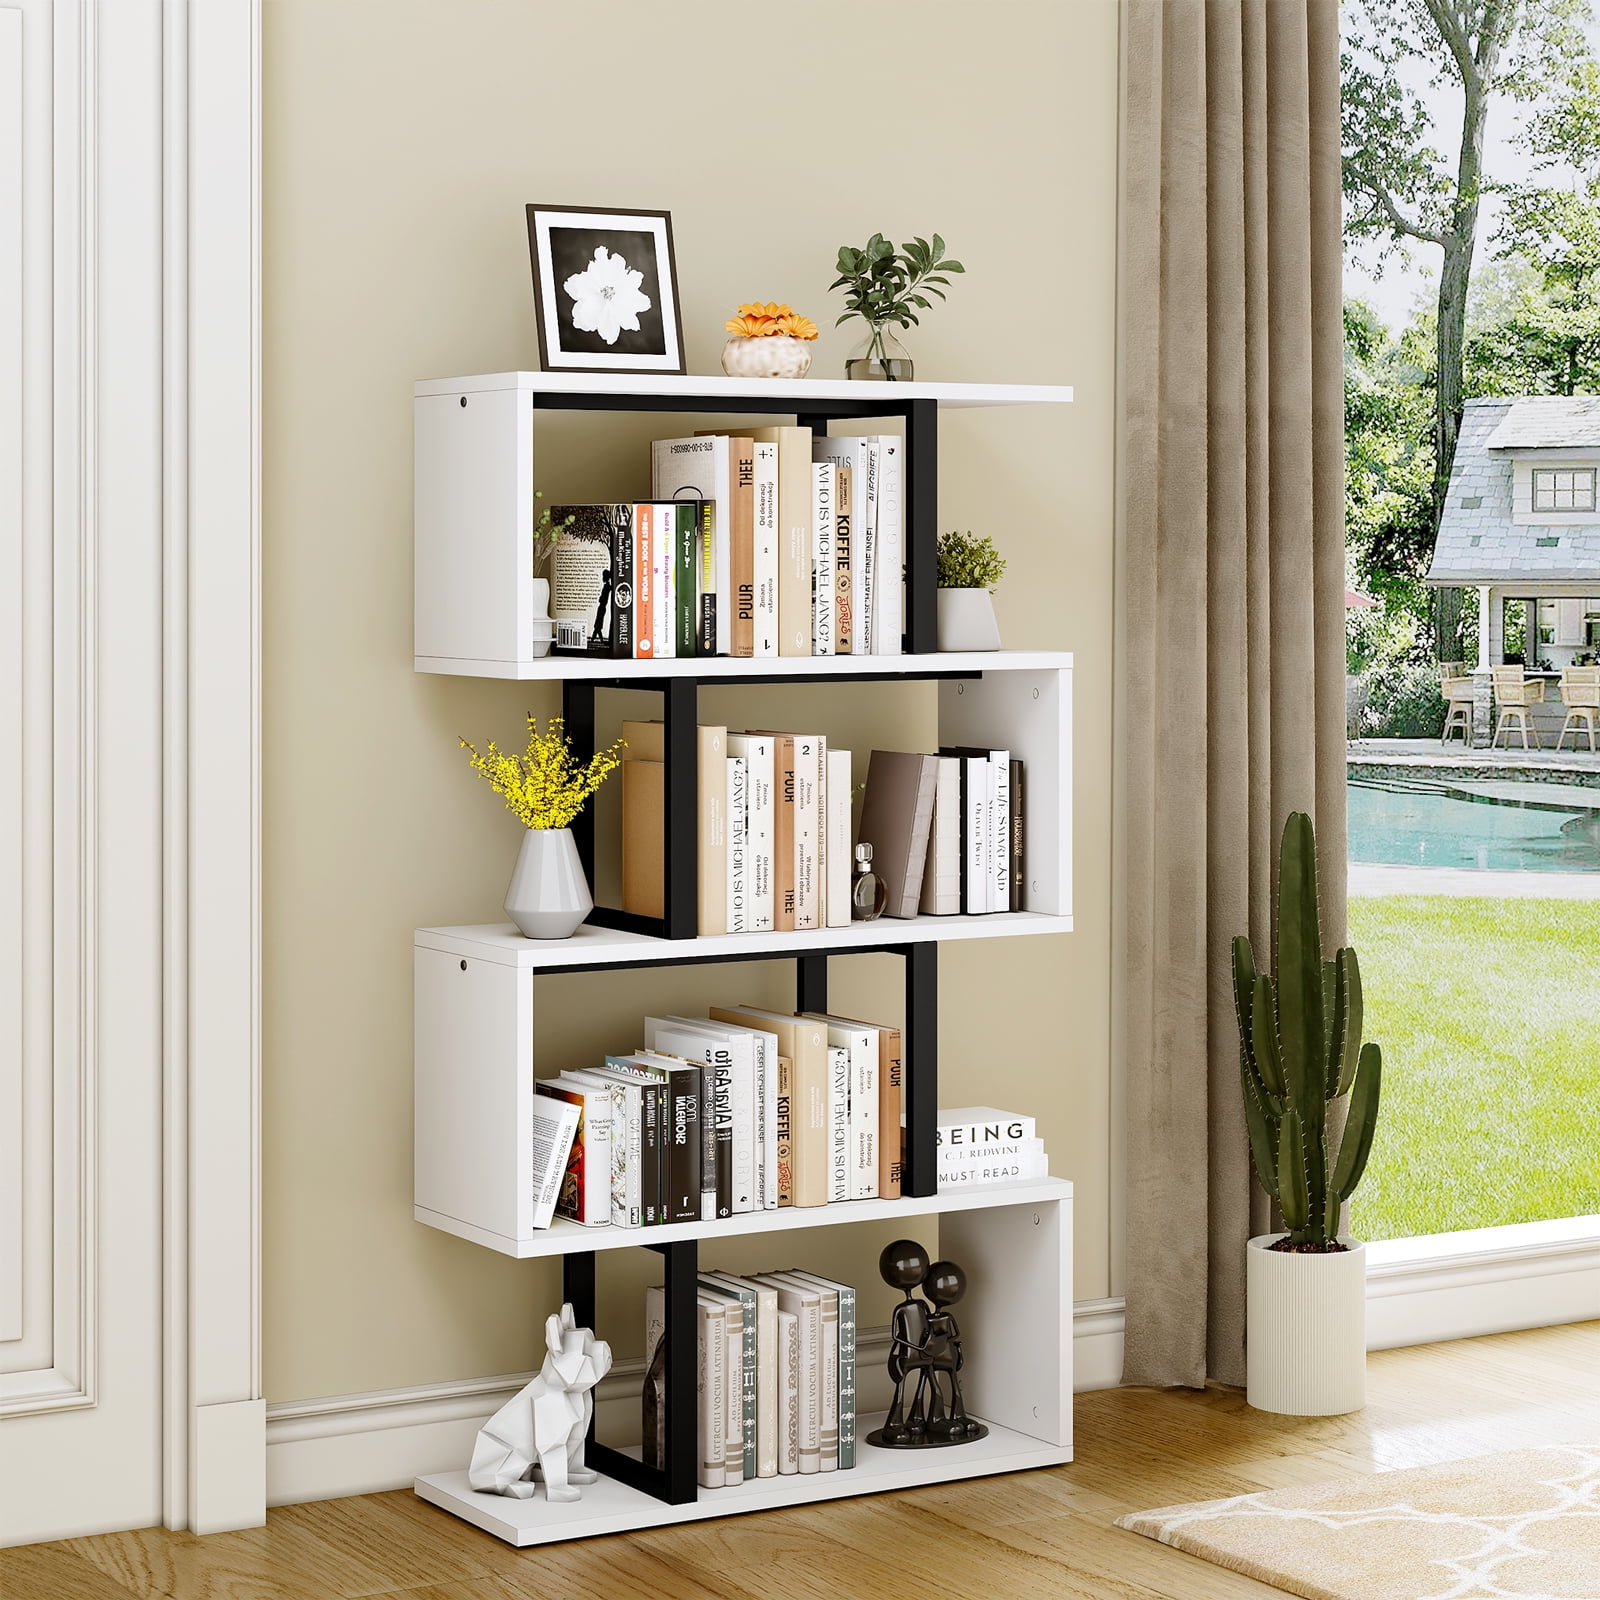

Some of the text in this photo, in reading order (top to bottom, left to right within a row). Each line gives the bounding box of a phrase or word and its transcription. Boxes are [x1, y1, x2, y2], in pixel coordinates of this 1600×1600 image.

[739, 459, 753, 619] PUUR THEE
[818, 464, 830, 642] WHO IS MICHAEL JANG?
[836, 515, 852, 634] KOFFIE STORIES
[759, 746, 765, 755] 1
[802, 745, 810, 755] 2
[734, 770, 743, 932] WHO IS MICHAEL JANG?
[862, 1038, 868, 1047] 1
[778, 1097, 789, 1141] KOFFIE
[835, 1061, 846, 1200] WHO IS MICHAEL JANG?
[744, 1372, 754, 1386] II
